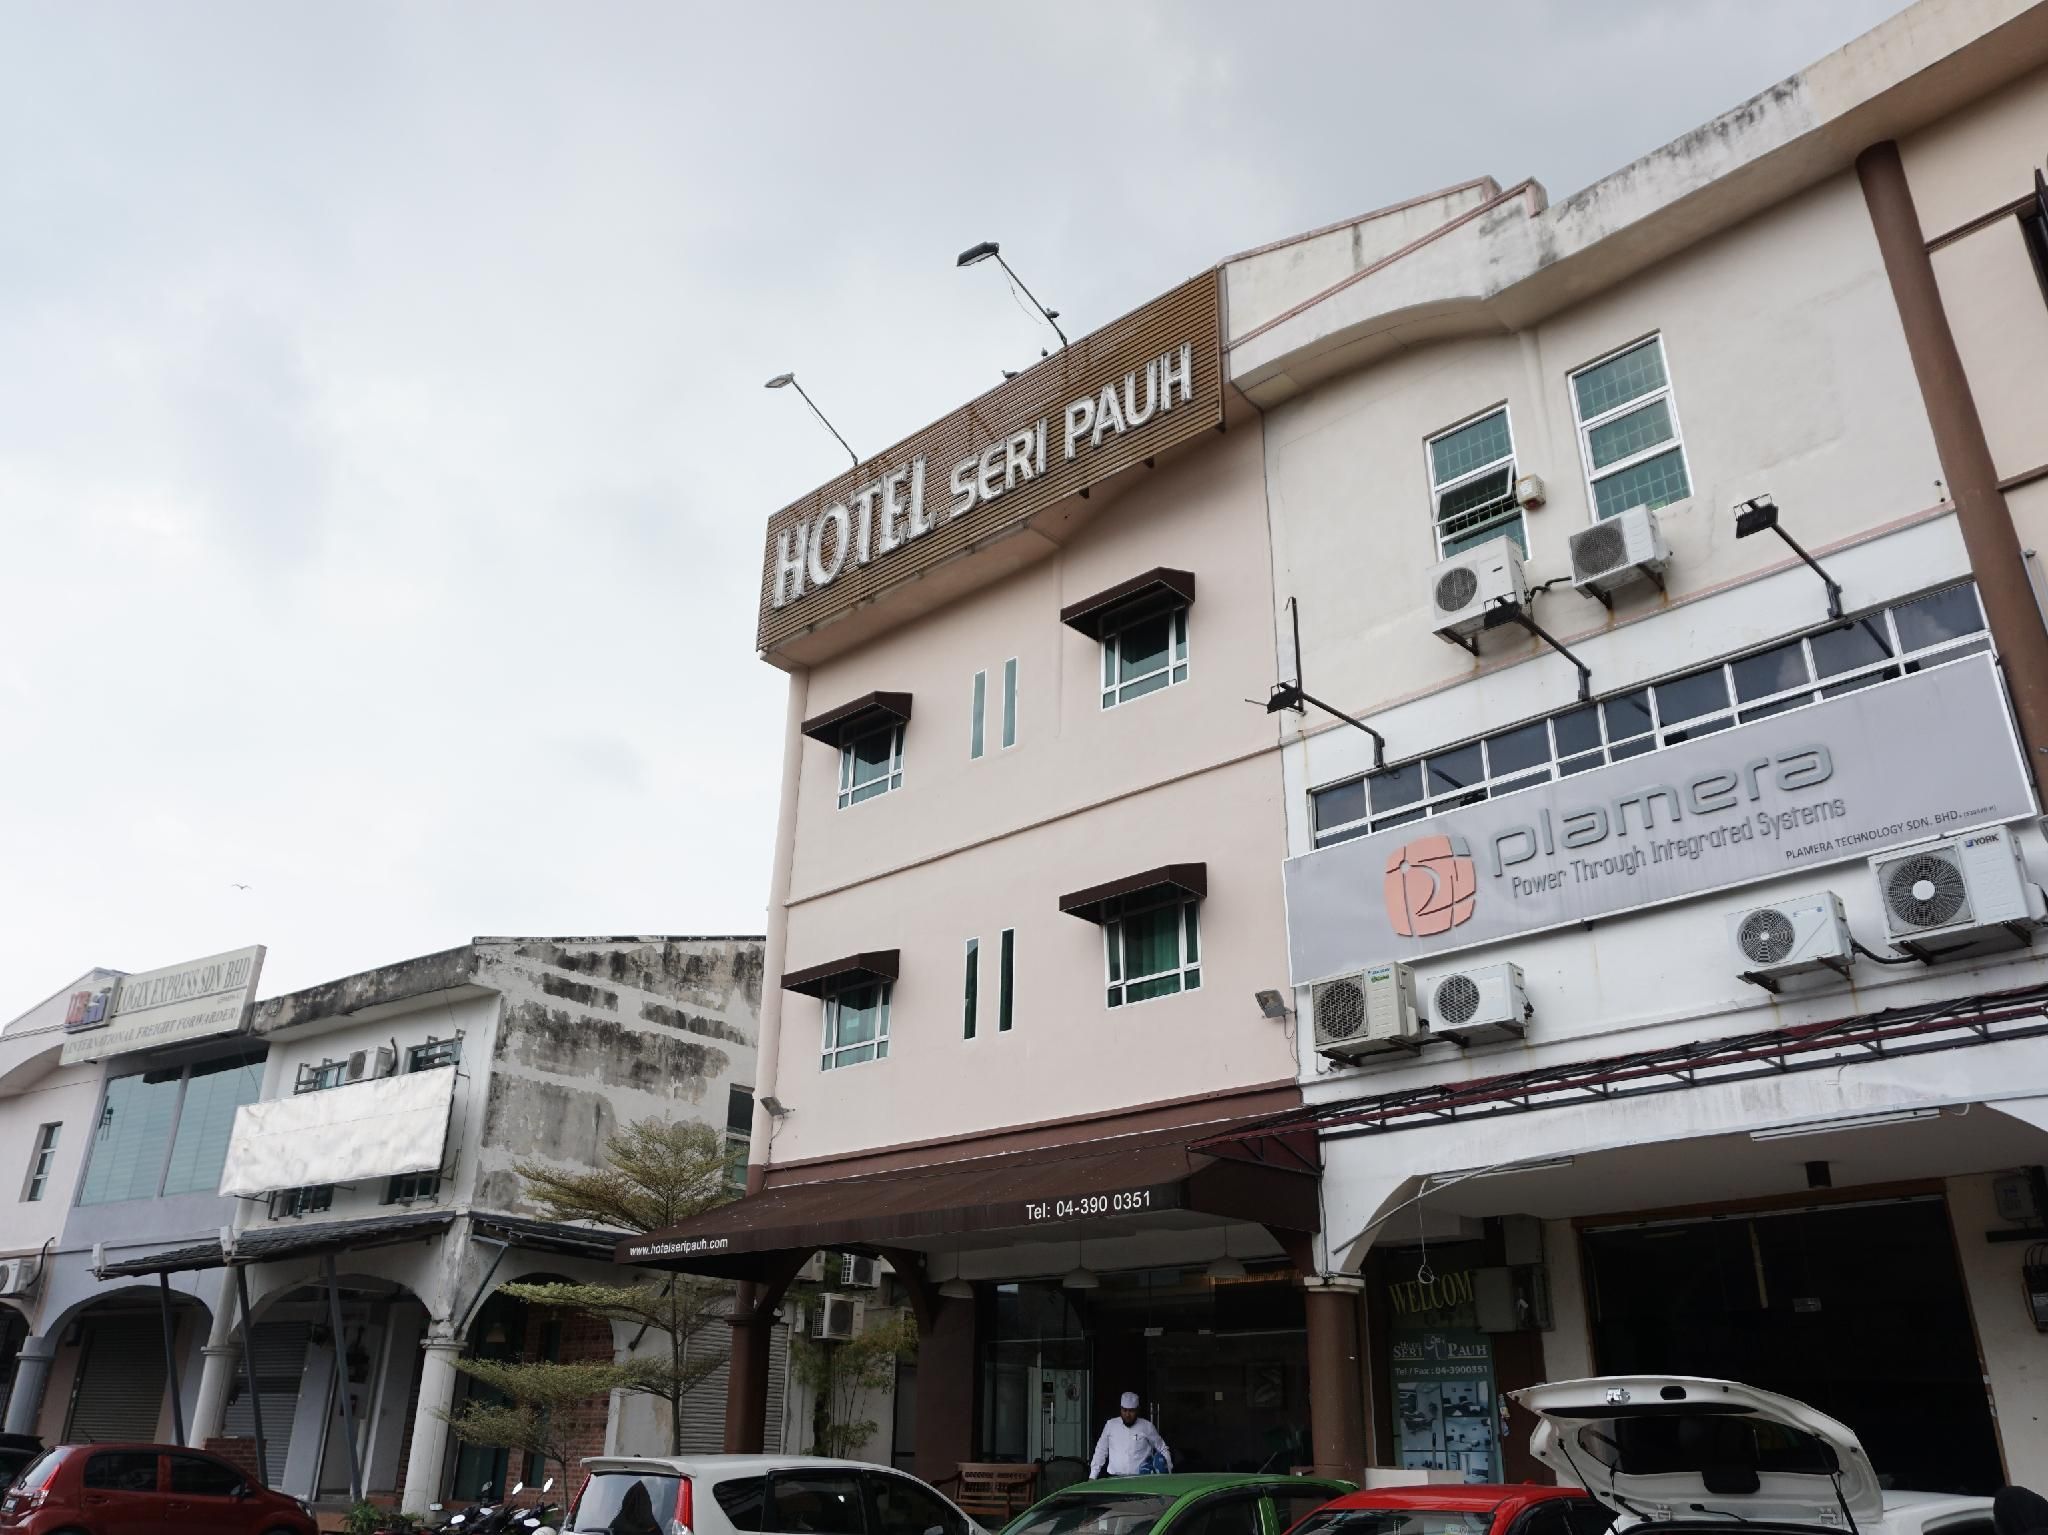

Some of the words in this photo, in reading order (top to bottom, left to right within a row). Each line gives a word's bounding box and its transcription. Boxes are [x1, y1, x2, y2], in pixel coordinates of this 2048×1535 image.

[773, 454, 935, 610] HOTEL
[949, 418, 1048, 518] SERI
[1064, 342, 1193, 460] PAUH
[1489, 743, 1834, 878] plamera
[1511, 869, 1567, 899] Power
[1572, 846, 1647, 884] Through
[1652, 814, 1754, 862] Integrated
[1759, 798, 1847, 841] Systems
[1786, 841, 1834, 860] PLAMERA
[1835, 822, 1905, 848] TECHNOLOGY
[1906, 816, 1933, 832] SDN.
[1935, 810, 1963, 824] BHD.
[1974, 832, 2000, 846] YORK
[151, 968, 199, 1005] EXPRESS
[200, 963, 224, 992] SDN
[225, 957, 250, 986] BHD
[135, 1019, 179, 1039] FREIGHT
[1026, 1202, 1051, 1220] Tel:
[1056, 1196, 1108, 1217] 04-390
[1114, 1190, 1150, 1210] 0351
[629, 1238, 728, 1256] www.hotelseripauh.com
[1388, 1270, 1474, 1315] WELCOM
[1447, 1343, 1488, 1356] PAUH
